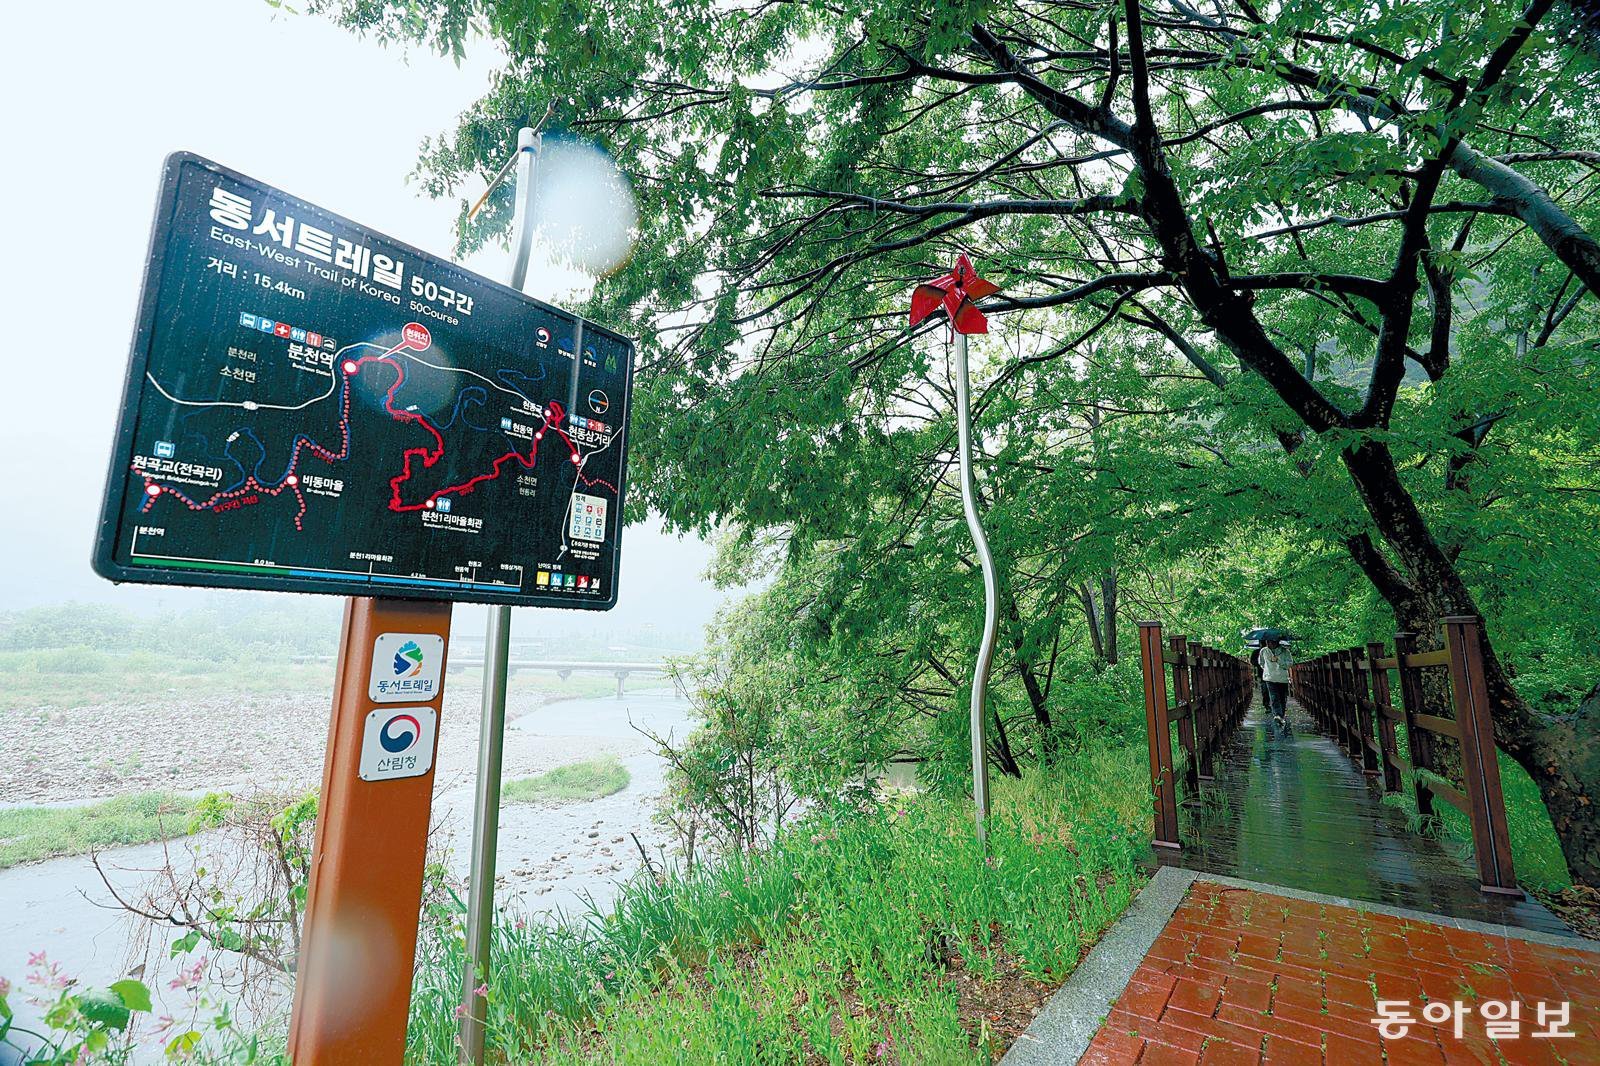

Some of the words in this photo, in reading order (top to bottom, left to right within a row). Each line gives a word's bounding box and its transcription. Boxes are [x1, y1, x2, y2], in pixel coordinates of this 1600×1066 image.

[208, 187, 404, 291] 동서트레일
[410, 275, 474, 316] 50구간
[210, 226, 300, 268] East-West
[304, 259, 338, 282] Trail
[341, 276, 357, 288] of
[360, 281, 400, 305] Korea
[207, 256, 238, 279] 거리
[253, 272, 305, 300] 15.4km
[409, 300, 459, 326] 50Course
[406, 328, 428, 342] 현위치
[228, 346, 257, 363] 분천리
[287, 342, 334, 370] 분천역
[220, 365, 256, 384] 소천면
[568, 425, 611, 448] 현동삼거리
[132, 455, 223, 481] 원곡교(전곡리)
[302, 475, 344, 492] 비동마을
[421, 510, 483, 529] 분천1리마을회관
[377, 679, 433, 693] 동서트레일
[377, 755, 417, 772] 산림청
